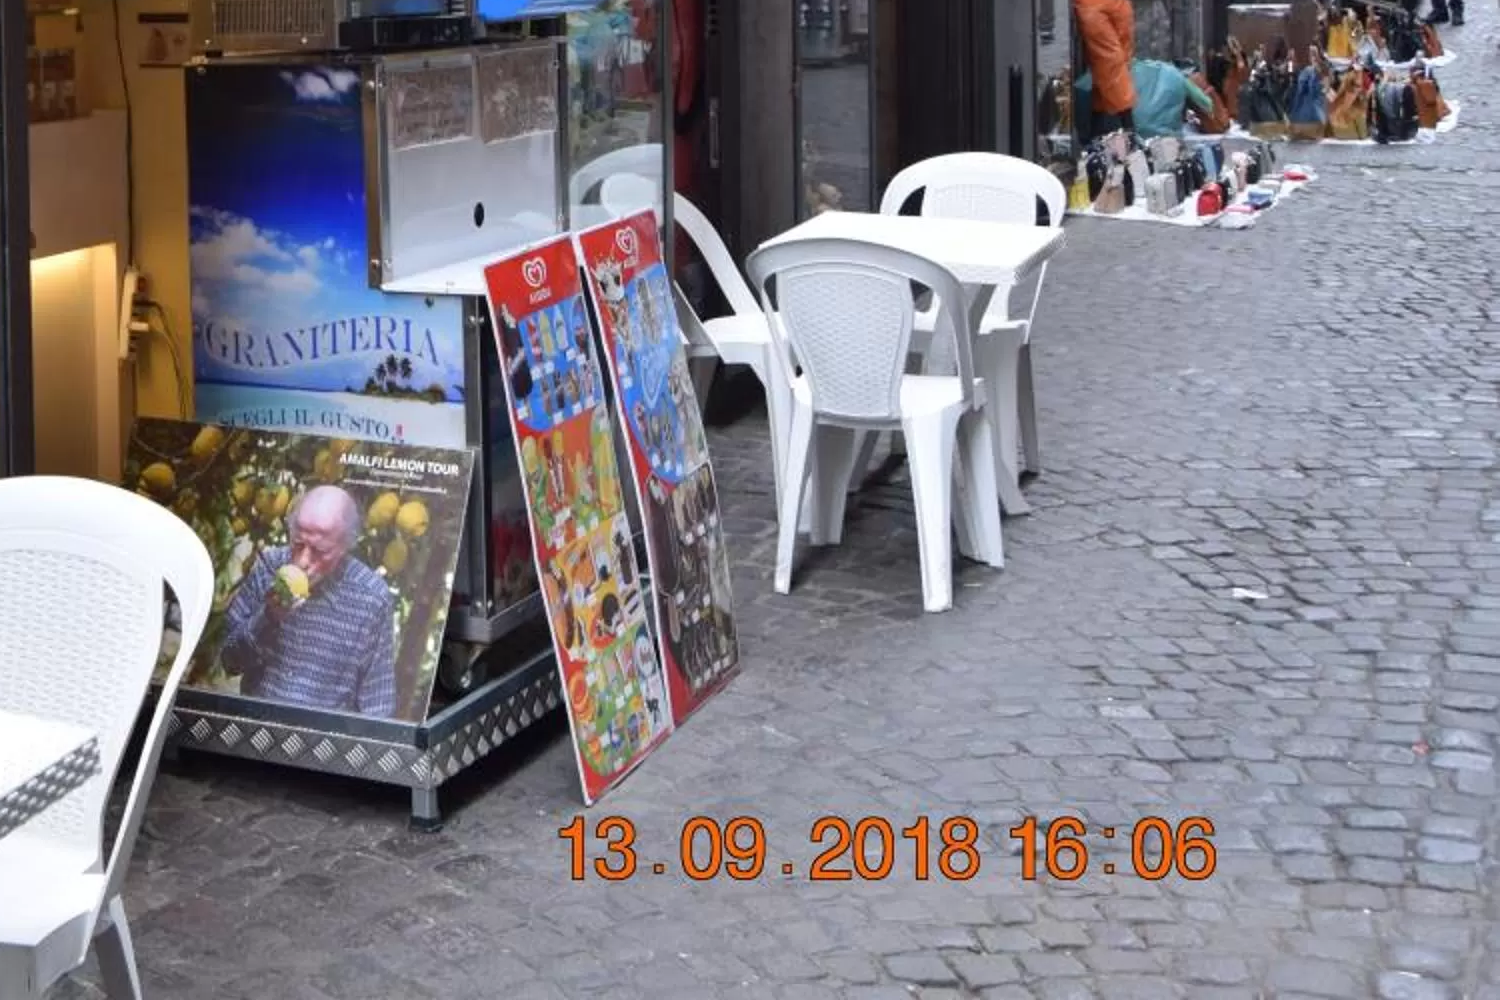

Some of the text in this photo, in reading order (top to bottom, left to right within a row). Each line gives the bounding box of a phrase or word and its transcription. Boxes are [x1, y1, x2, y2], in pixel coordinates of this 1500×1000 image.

[204, 314, 441, 369] GRANITERIA
[293, 408, 315, 427] IL
[339, 452, 383, 469] AMALFI
[383, 456, 425, 473] LEMON
[426, 461, 460, 476] TOUR
